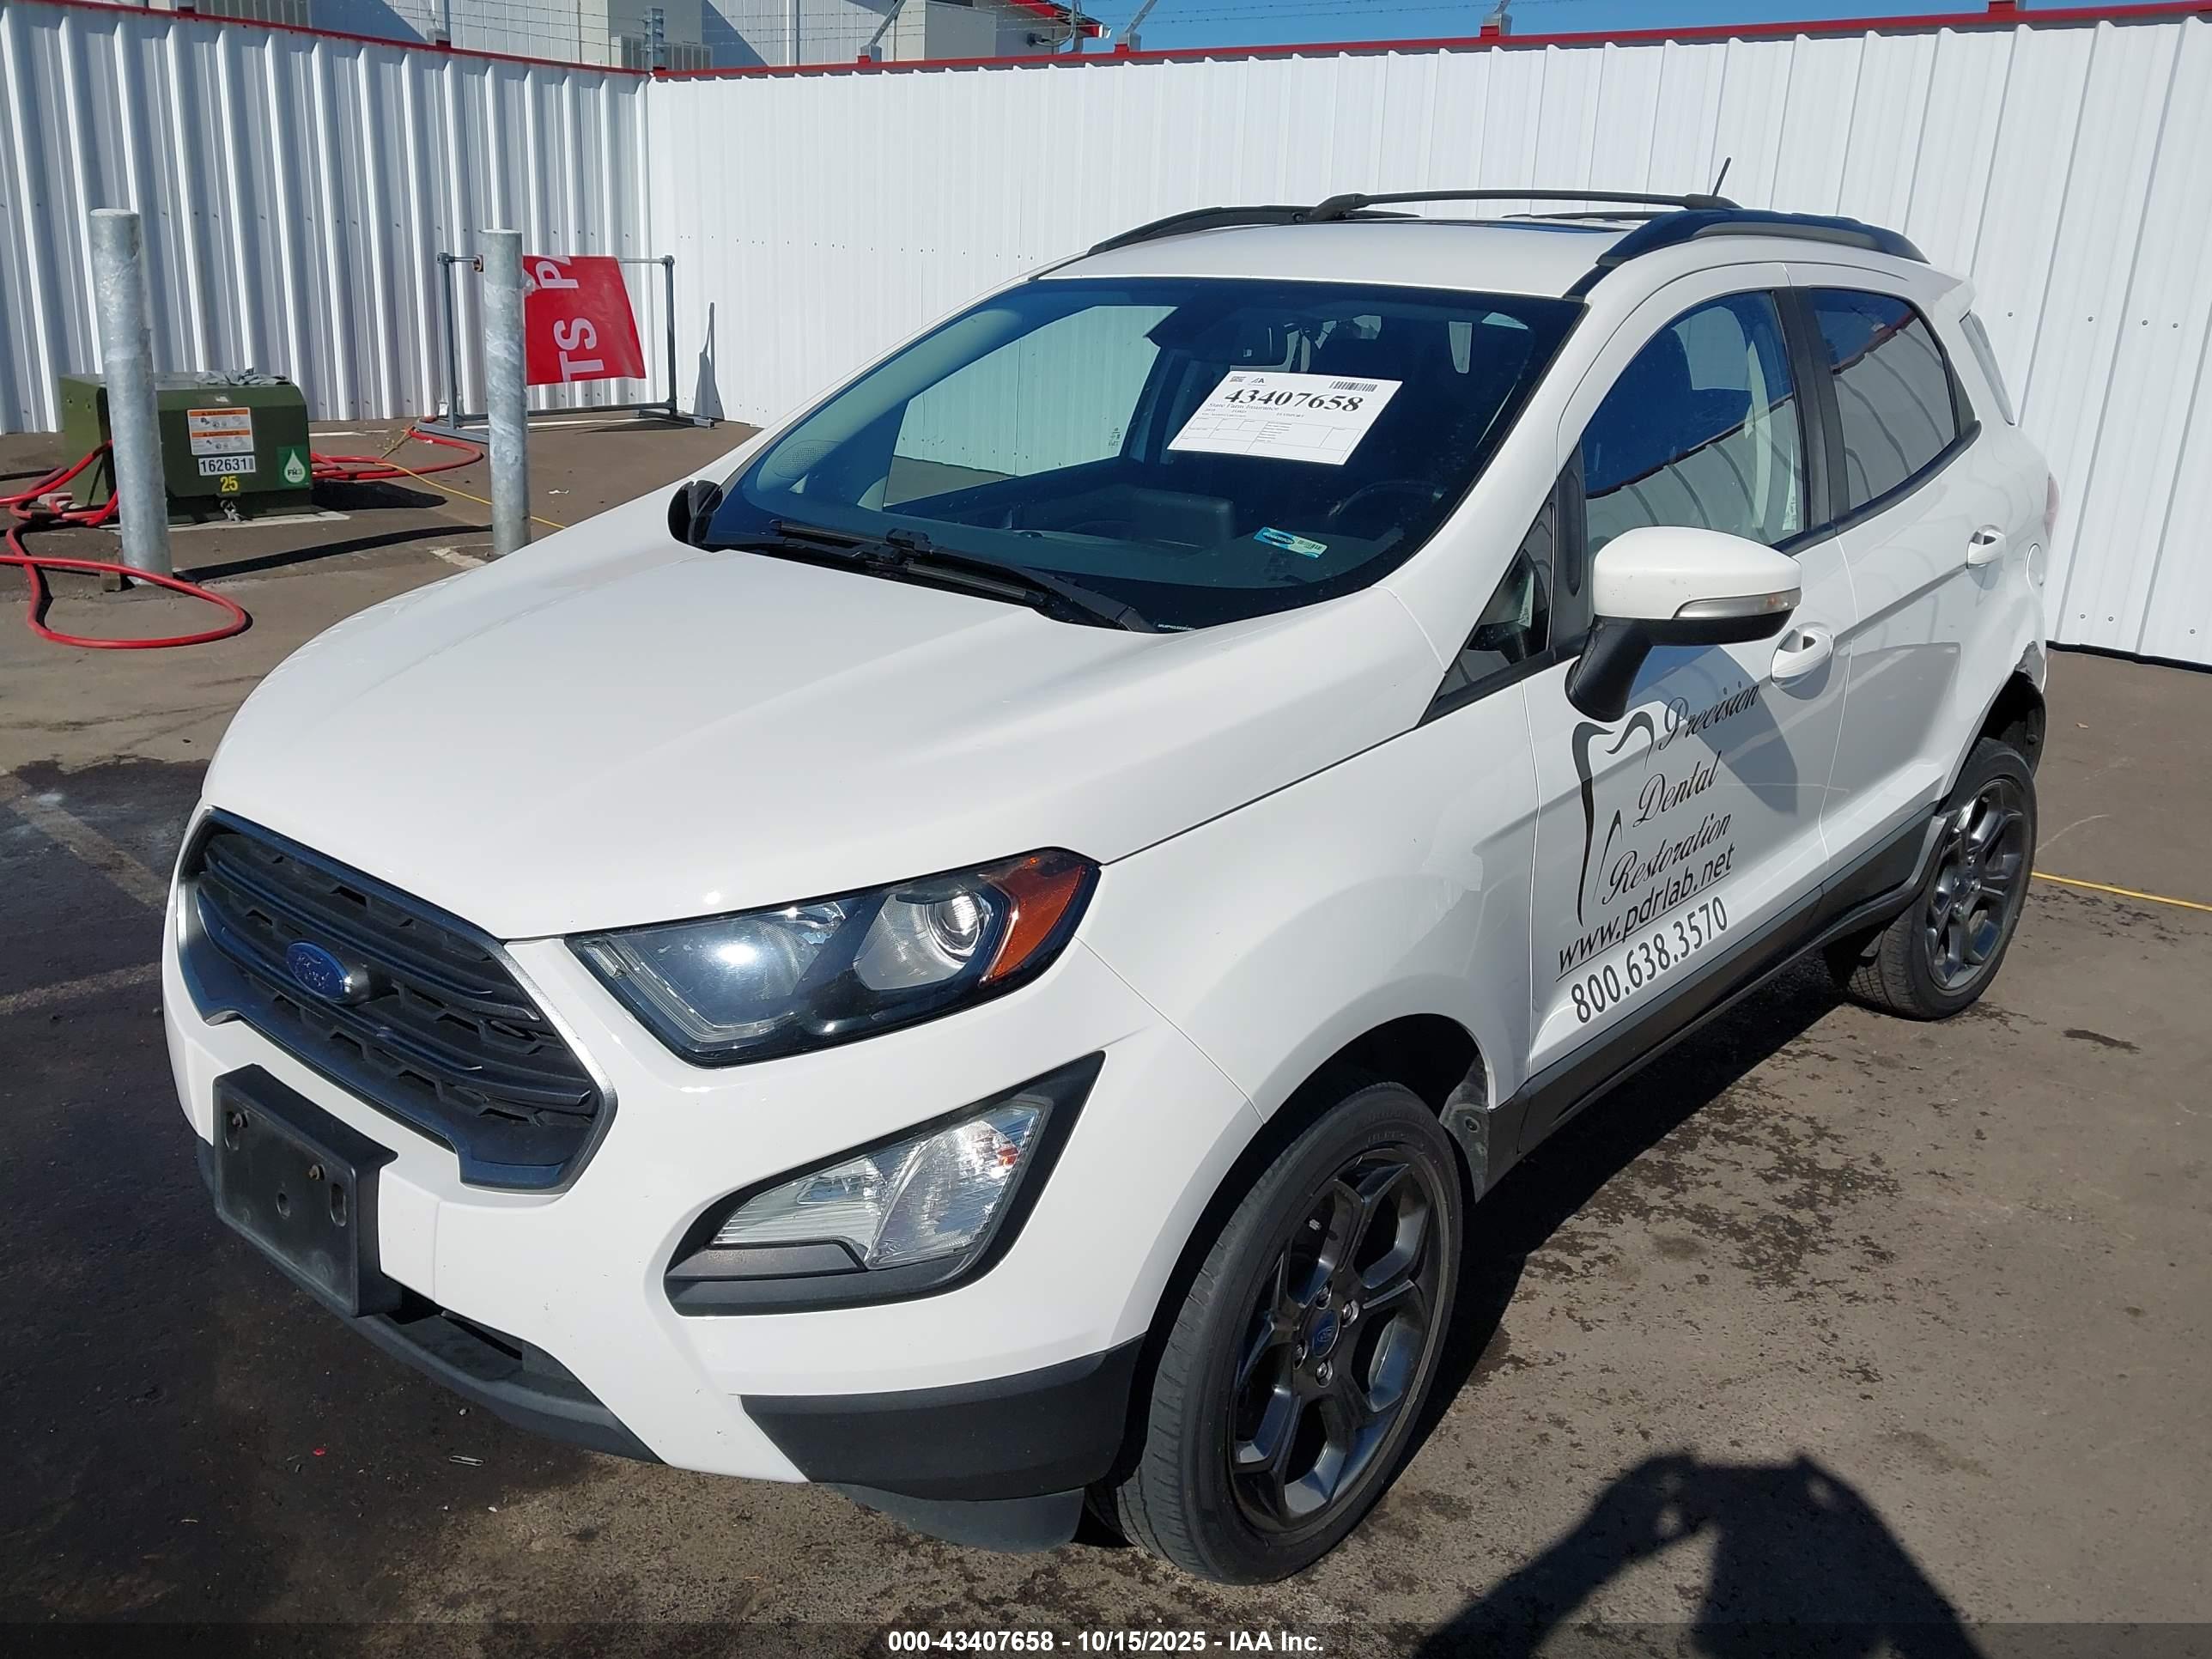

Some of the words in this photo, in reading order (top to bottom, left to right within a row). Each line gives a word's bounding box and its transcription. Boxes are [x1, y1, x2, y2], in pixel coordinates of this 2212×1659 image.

[1224, 389, 1364, 412] 43407658
[200, 458, 247, 473] 162631
[220, 476, 239, 493] 25
[1658, 680, 1760, 750] Precision
[1632, 750, 1722, 828] Dental
[1601, 812, 1732, 905] Restoration
[1558, 842, 1735, 975] www.pdrlab.net
[1571, 896, 1728, 1024] 800.638.3570
